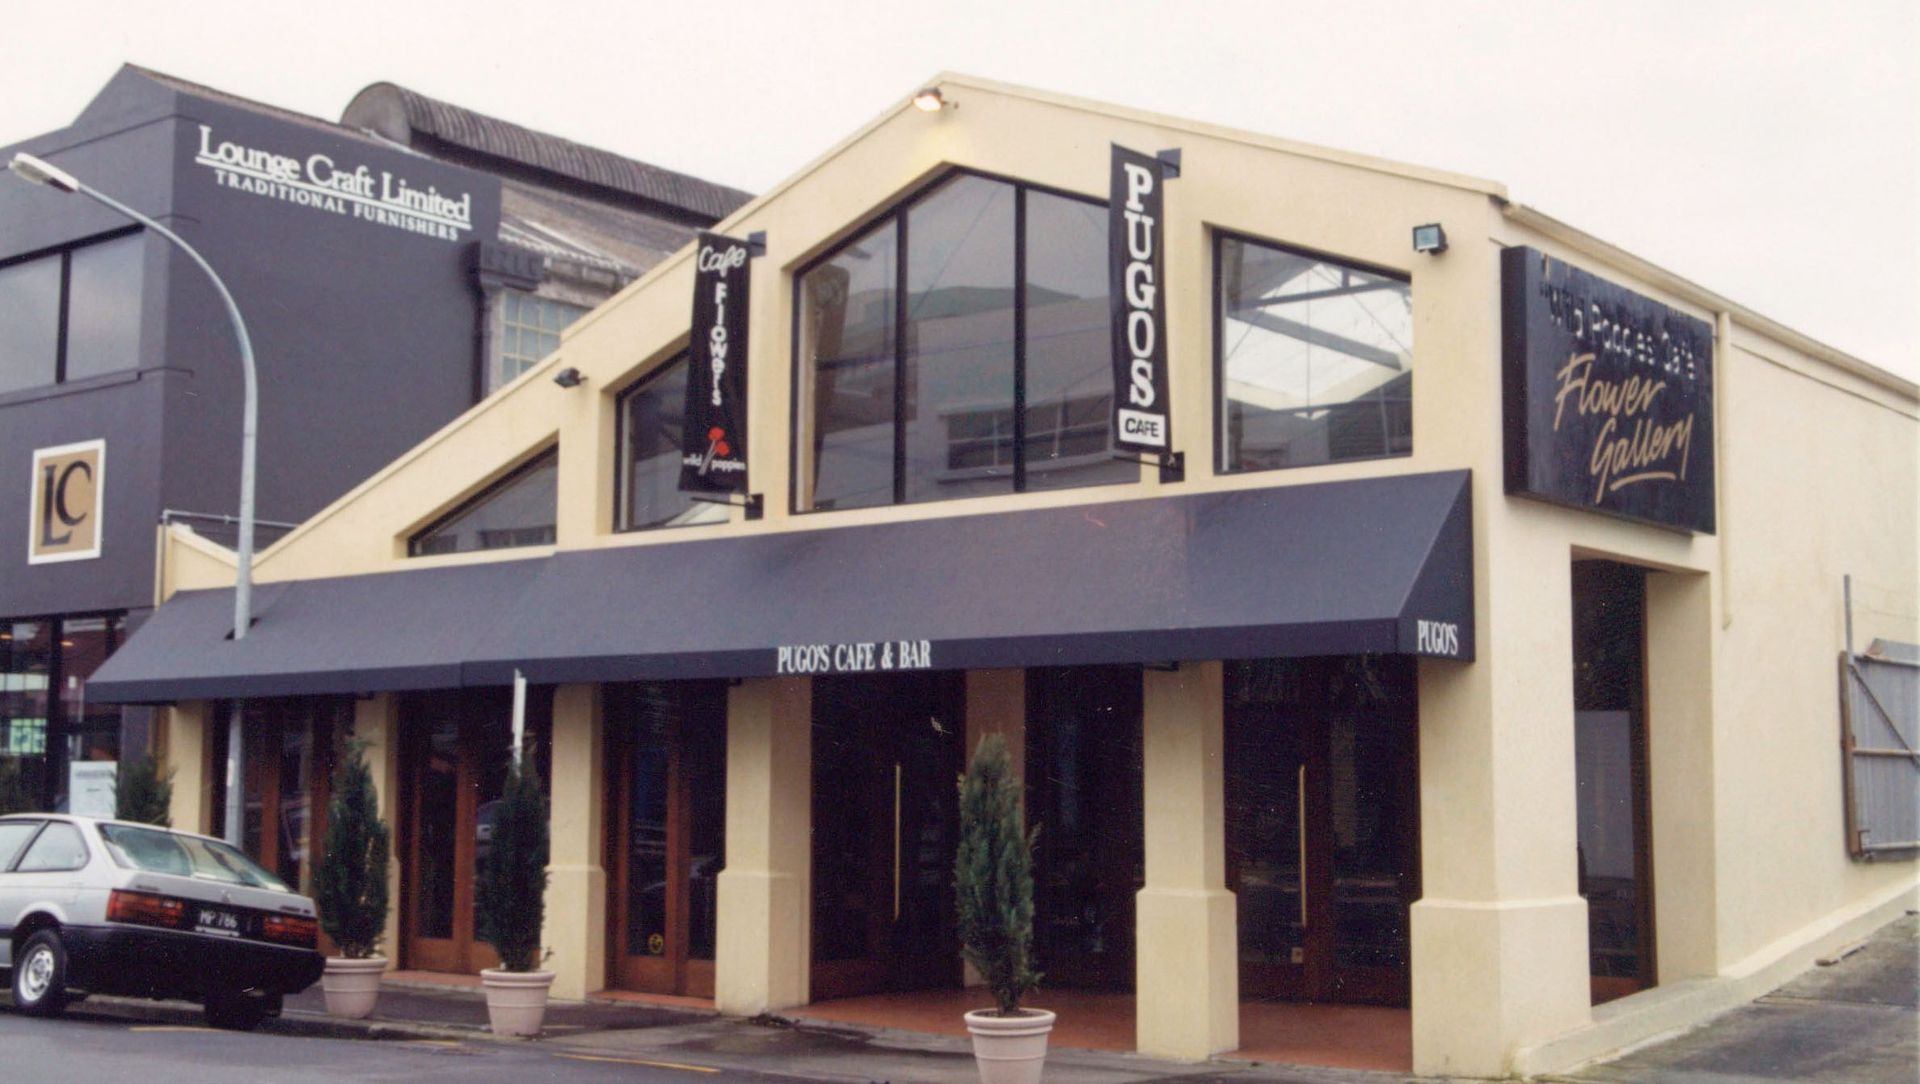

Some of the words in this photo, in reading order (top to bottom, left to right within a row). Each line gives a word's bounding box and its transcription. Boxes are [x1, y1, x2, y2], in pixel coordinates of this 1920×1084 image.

[199, 125, 299, 182] Lounge
[306, 154, 375, 199] Craft
[381, 171, 471, 222] Limited
[215, 169, 347, 215] TRADITIONAL
[353, 203, 459, 241] FURNISHERS
[699, 245, 747, 278] Cafe
[1124, 162, 1156, 407] PUGOS
[1124, 417, 1160, 438] CAFE
[1553, 352, 1667, 433] Flower
[1590, 413, 1694, 505] Gallery
[42, 459, 92, 547] LC
[777, 644, 830, 674] PUGO'S
[834, 642, 876, 672] CAFE
[881, 641, 894, 670] &
[898, 639, 932, 669] BAR
